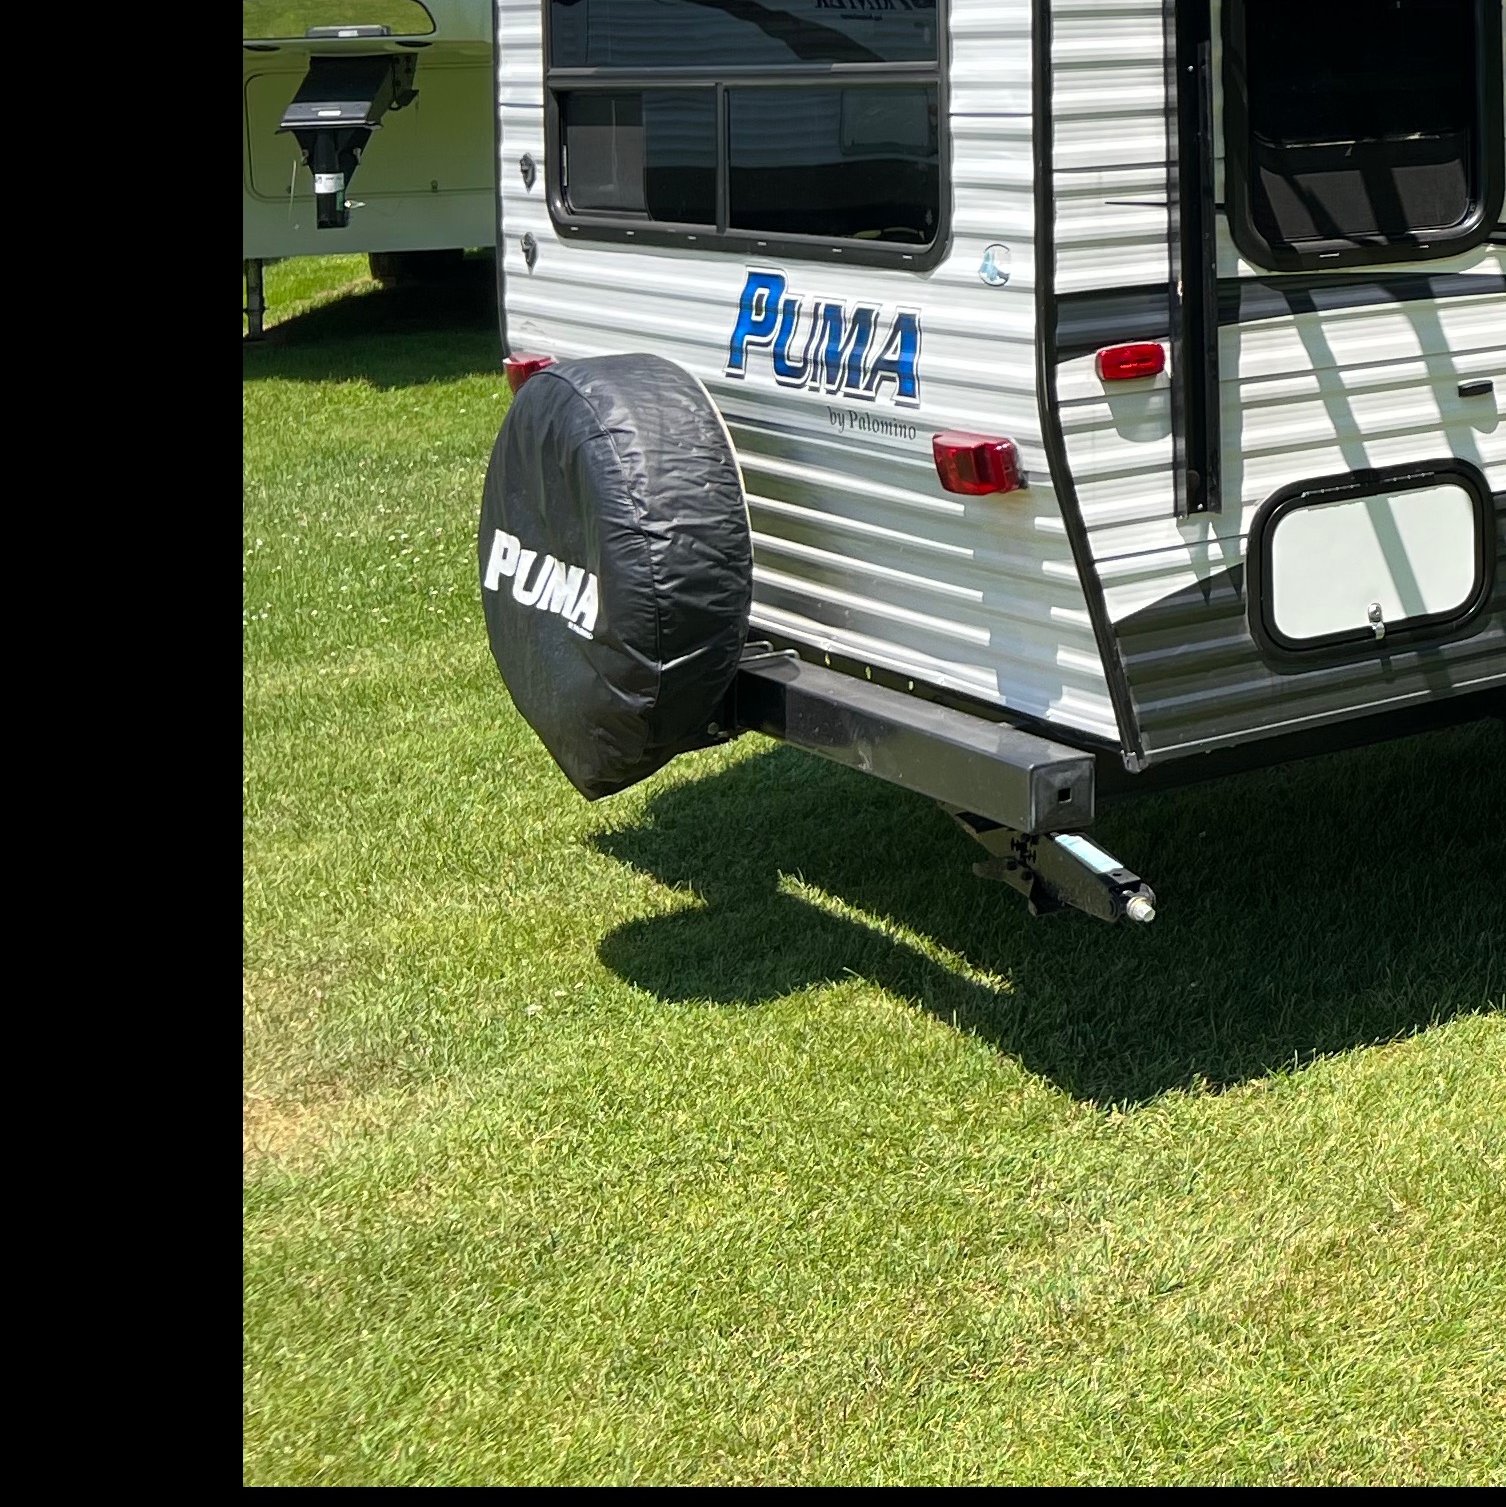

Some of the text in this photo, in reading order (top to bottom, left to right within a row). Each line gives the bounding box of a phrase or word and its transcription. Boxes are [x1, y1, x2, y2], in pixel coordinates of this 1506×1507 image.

[722, 264, 923, 410] PUMA
[827, 405, 917, 441] by Palomino
[483, 527, 599, 632] PUMA
